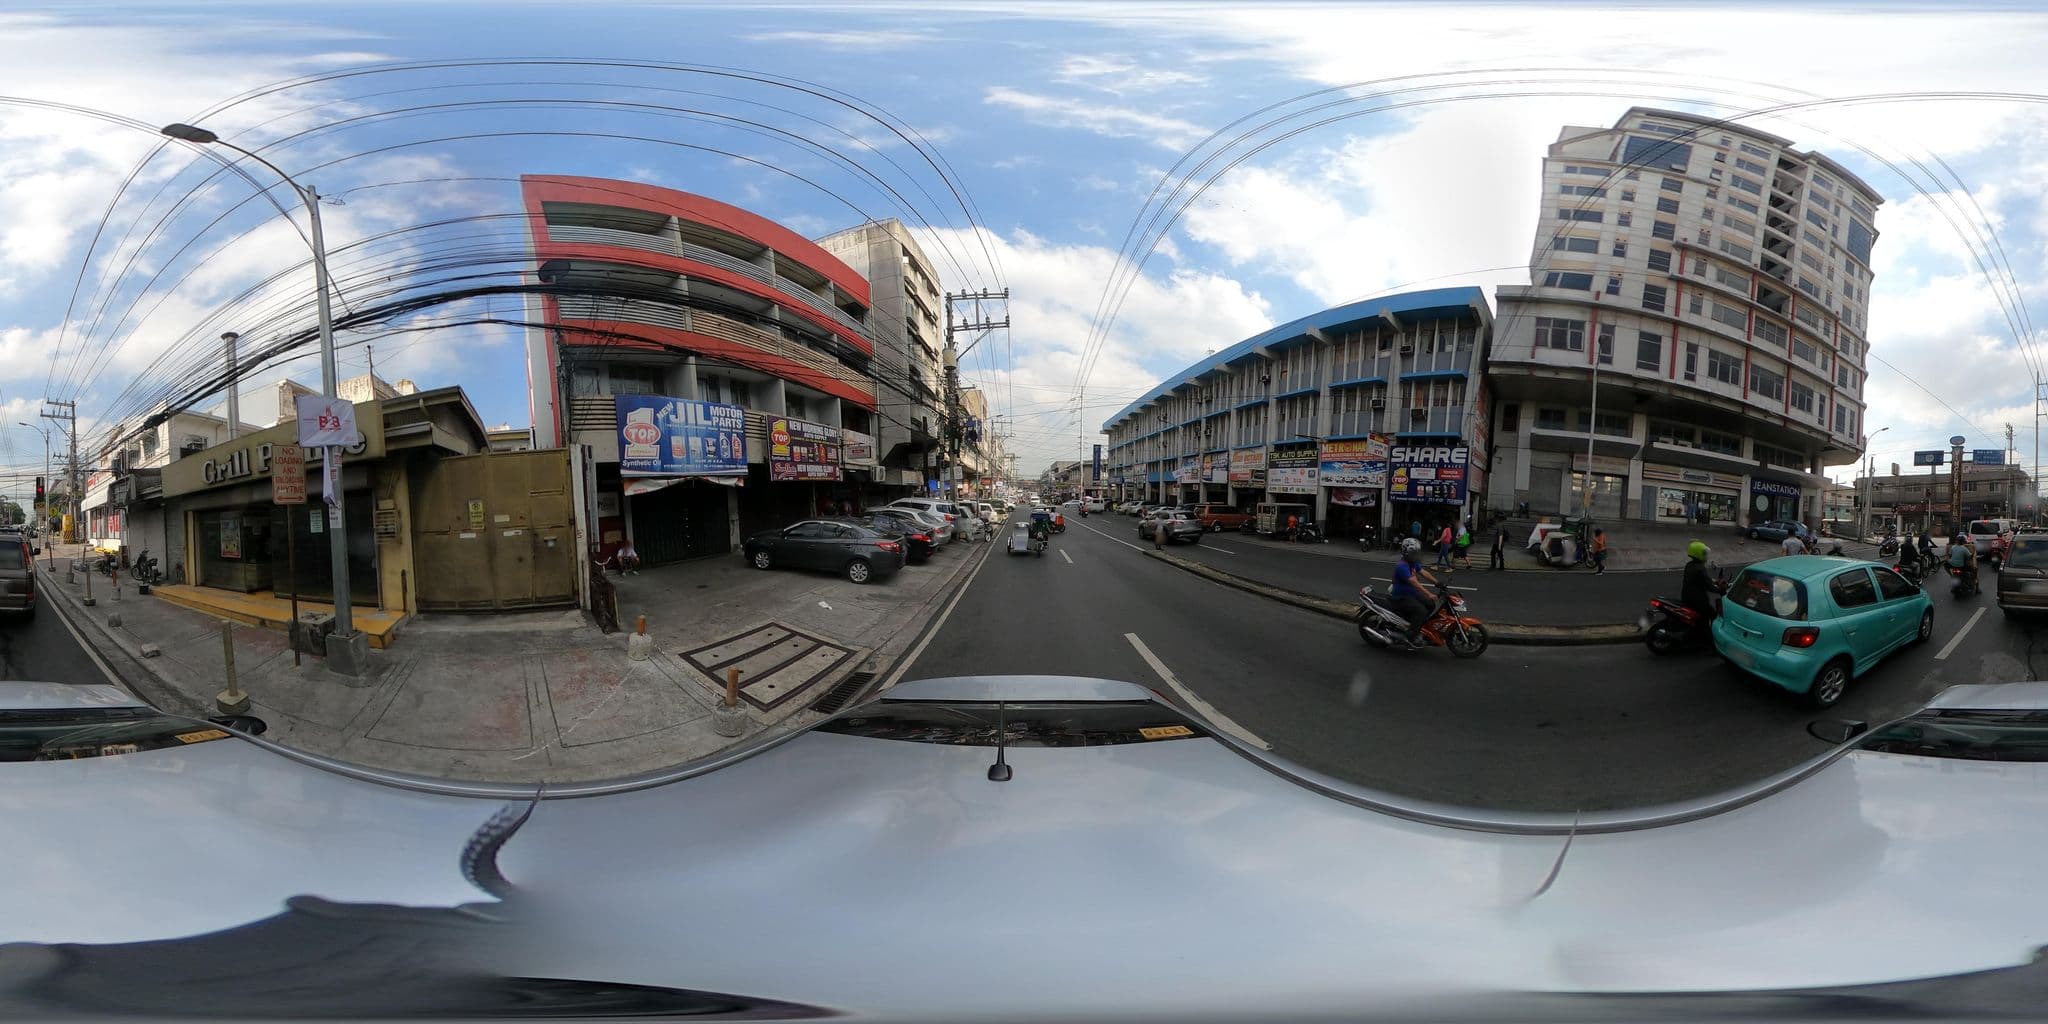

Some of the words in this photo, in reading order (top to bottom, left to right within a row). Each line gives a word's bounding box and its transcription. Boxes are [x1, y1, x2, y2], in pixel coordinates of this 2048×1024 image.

[656, 401, 674, 420] NEW
[668, 402, 712, 426] JIL
[709, 405, 743, 419] MOTOR
[712, 416, 742, 429] PARTS
[628, 427, 656, 442] TOP
[774, 433, 788, 442] TOP
[282, 447, 294, 455] NO
[1297, 450, 1318, 458] SUPPLY
[1390, 447, 1468, 464] SHARE
[200, 447, 250, 485] Grill
[274, 456, 303, 464] LOADING
[1752, 480, 1801, 497] JEANSTATION
